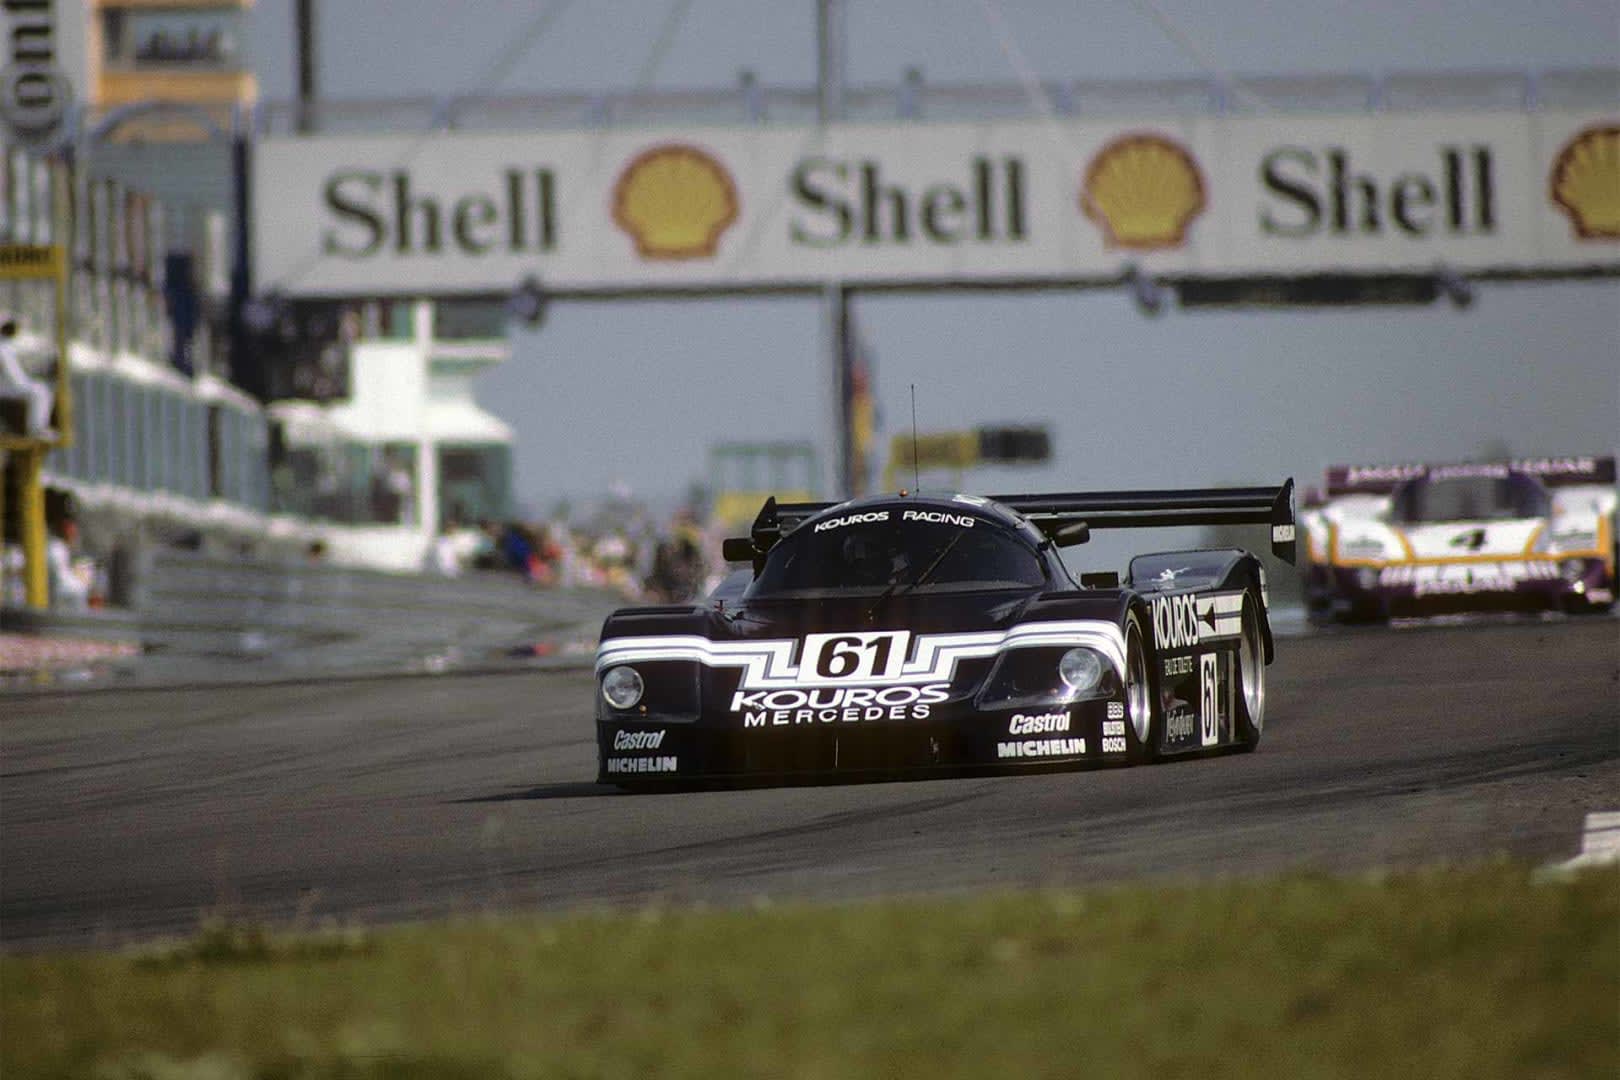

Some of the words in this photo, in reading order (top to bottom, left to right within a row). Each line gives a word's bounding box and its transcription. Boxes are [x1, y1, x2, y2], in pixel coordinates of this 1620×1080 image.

[790, 153, 1028, 247] Shell
[1258, 144, 1496, 238] Shell
[322, 166, 557, 258] Shell
[814, 511, 890, 533] KOUROS
[902, 510, 975, 528] RACING
[1151, 594, 1199, 650] KOUROS
[816, 636, 893, 678] 61
[730, 683, 951, 712] KOUROS
[1204, 660, 1216, 738] 61
[744, 704, 930, 728] MERCEDES
[1009, 711, 1071, 735] Castrol
[613, 729, 666, 750] Castrol
[997, 738, 1087, 758] MICHELIN
[1102, 737, 1127, 753] BOSCH
[607, 756, 678, 773] MICHELIN
